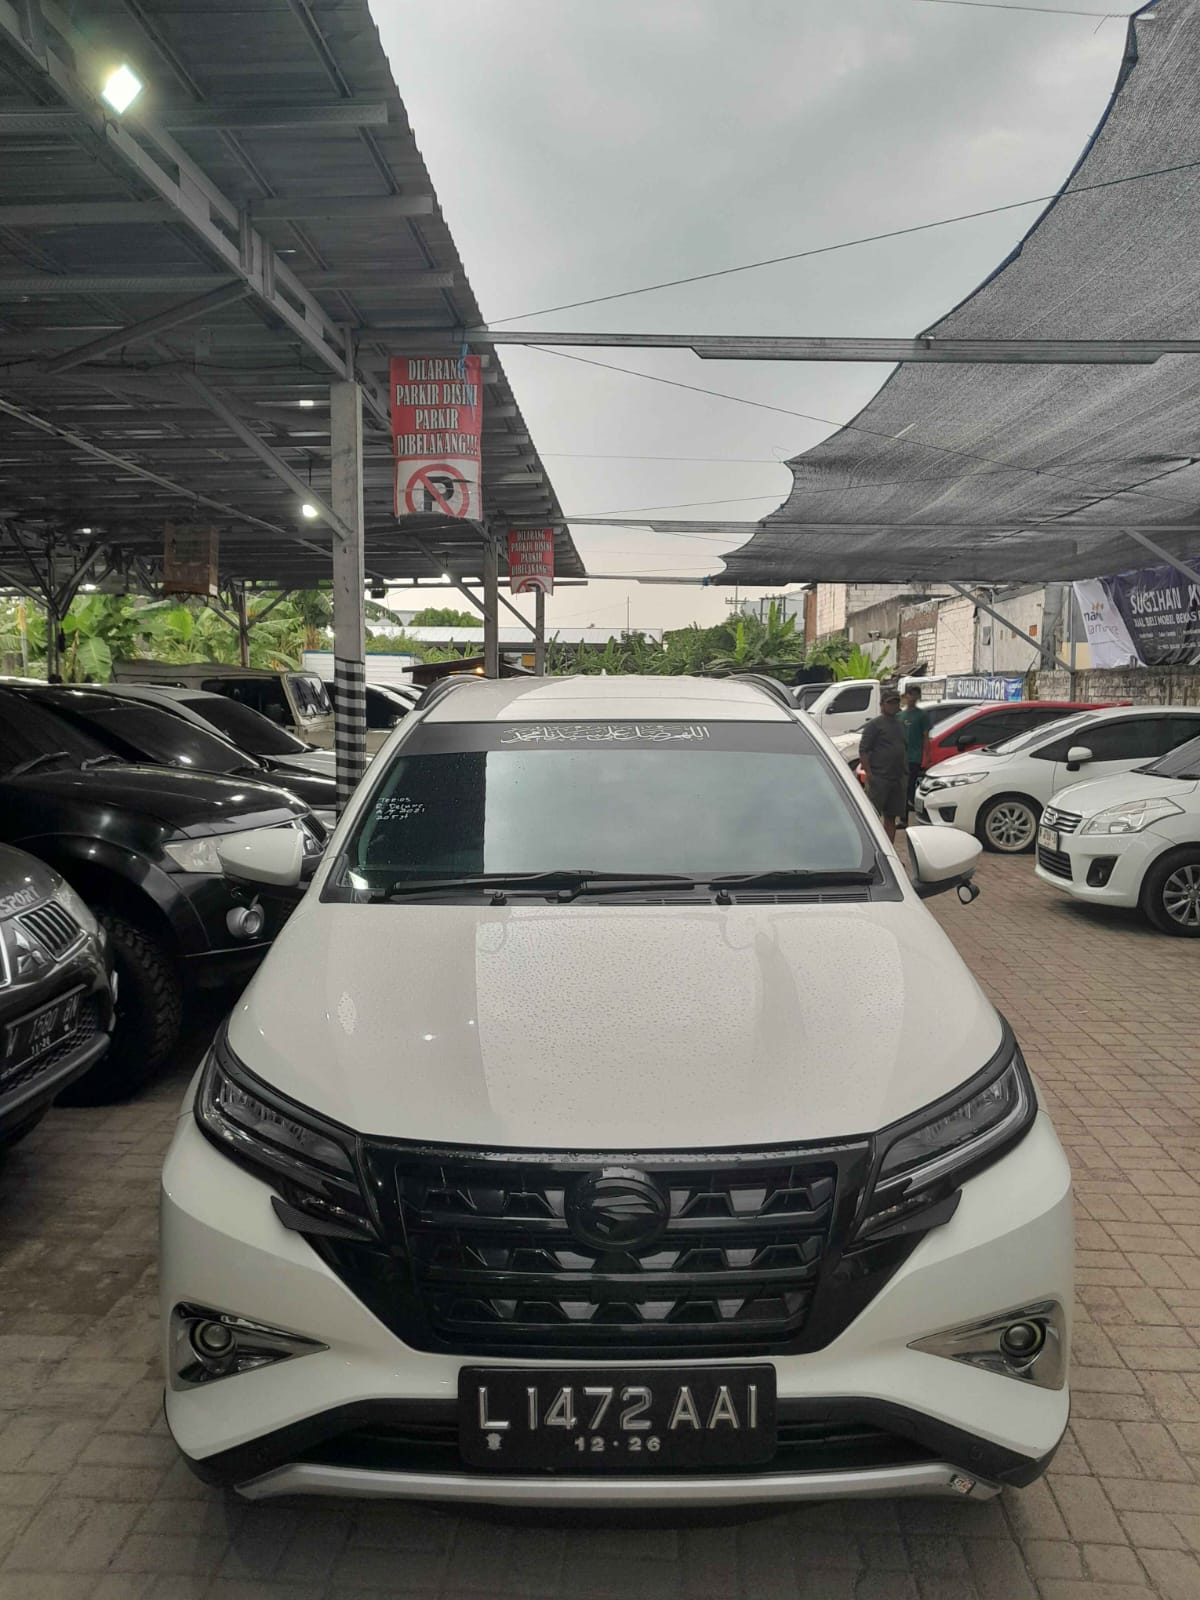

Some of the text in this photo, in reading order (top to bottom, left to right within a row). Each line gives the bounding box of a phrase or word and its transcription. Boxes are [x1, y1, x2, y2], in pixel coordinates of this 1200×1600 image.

[408, 359, 465, 381] DILARANG
[396, 383, 478, 406] PARKIR DISINI
[415, 408, 458, 430] PARKIR
[397, 433, 477, 456] DIBELAKANG!!!
[1131, 587, 1182, 614] SUGIHAN
[1176, 610, 1198, 624] BEKAS
[0, 885, 40, 913] SPORT
[479, 1386, 509, 1430] L
[527, 1386, 653, 1430] 1472
